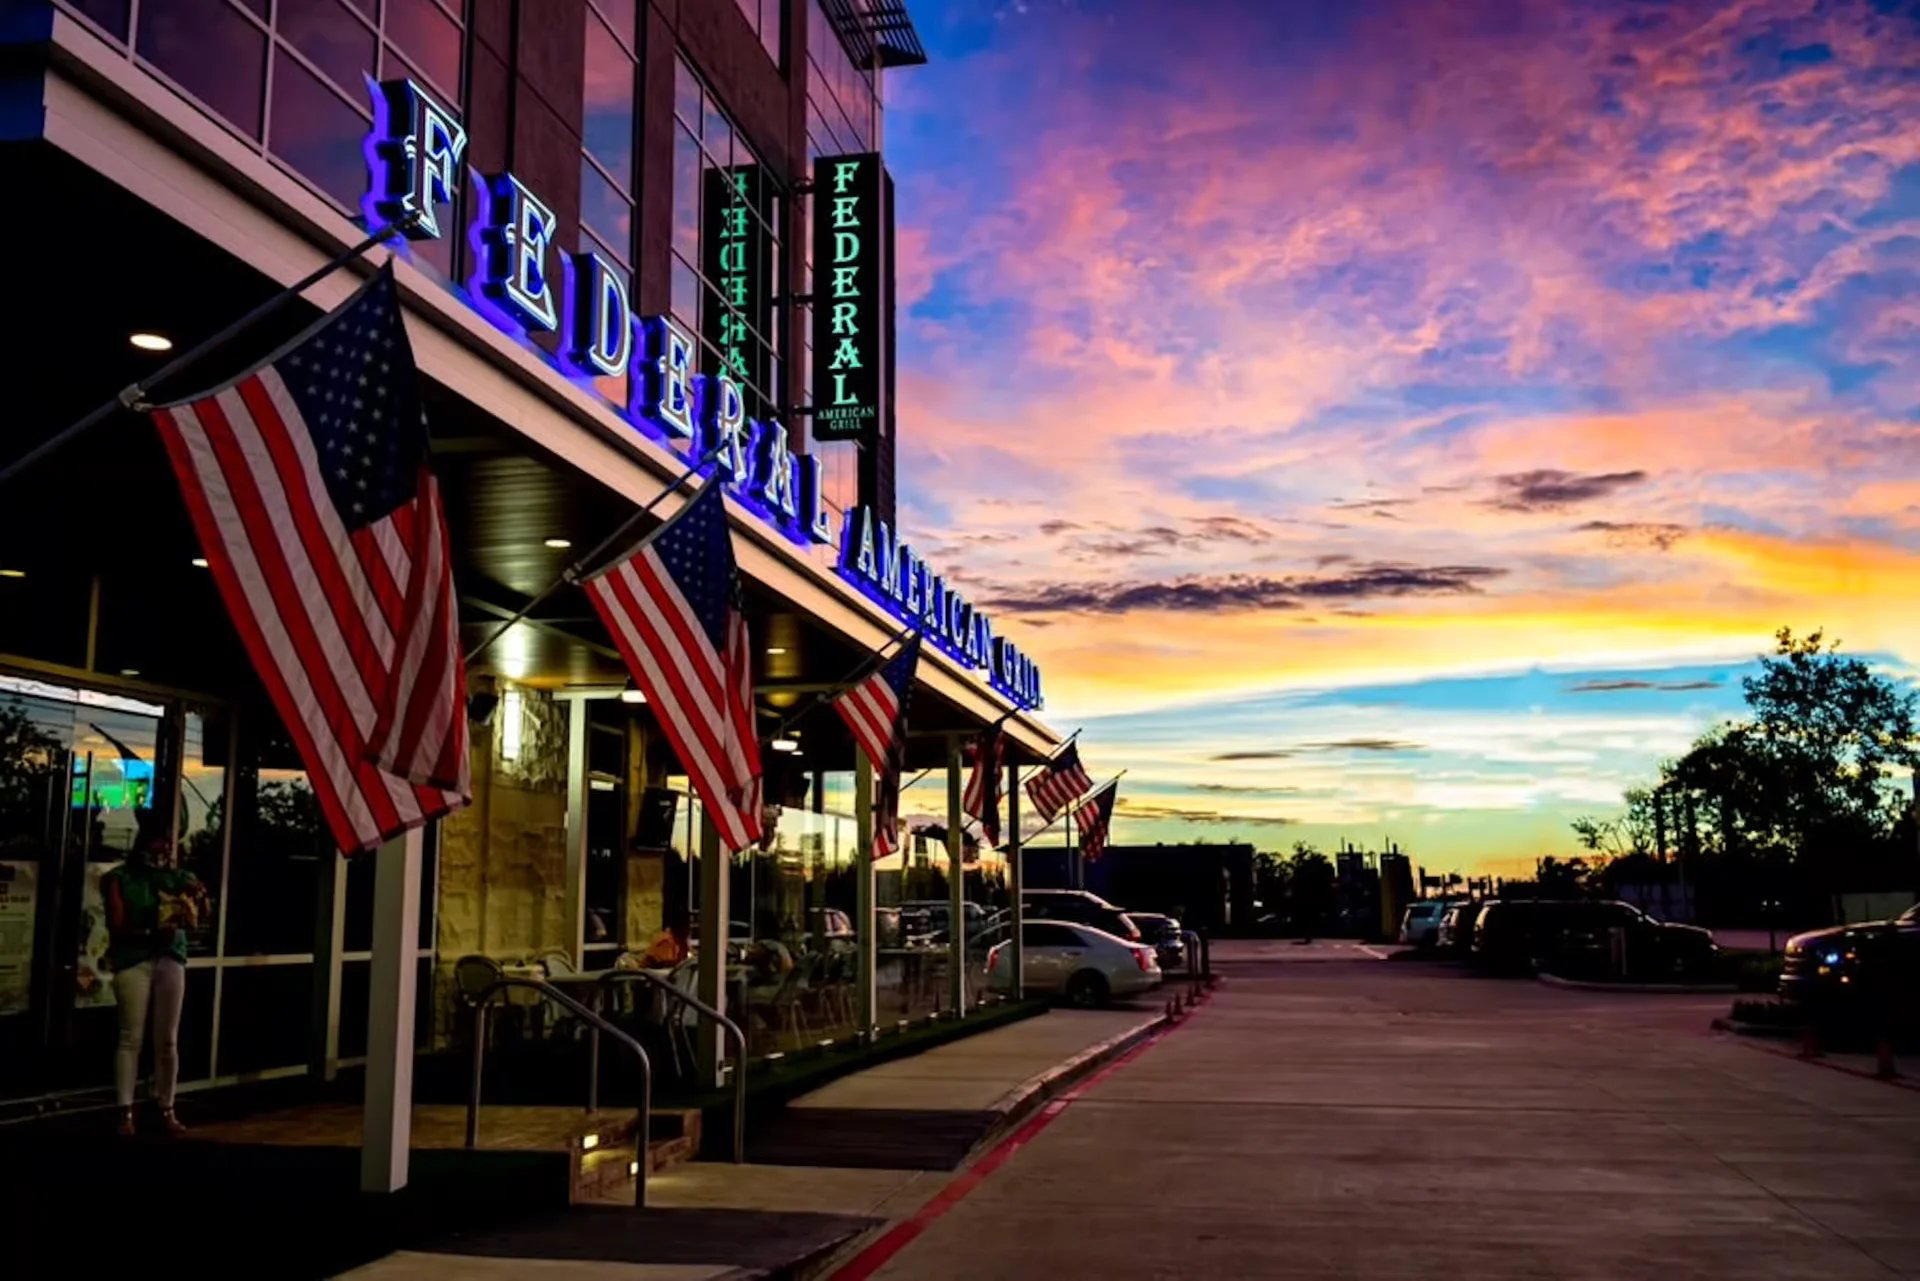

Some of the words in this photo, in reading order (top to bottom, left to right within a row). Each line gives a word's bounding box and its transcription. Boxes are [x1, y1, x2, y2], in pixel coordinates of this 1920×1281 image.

[828, 162, 863, 405] FEDERAL
[398, 78, 832, 544] FEDERAL
[857, 505, 996, 672] AMERICAN
[1003, 635, 1044, 711] GRILL
[817, 404, 875, 420] AMERICAN
[829, 418, 863, 430] GRILL
